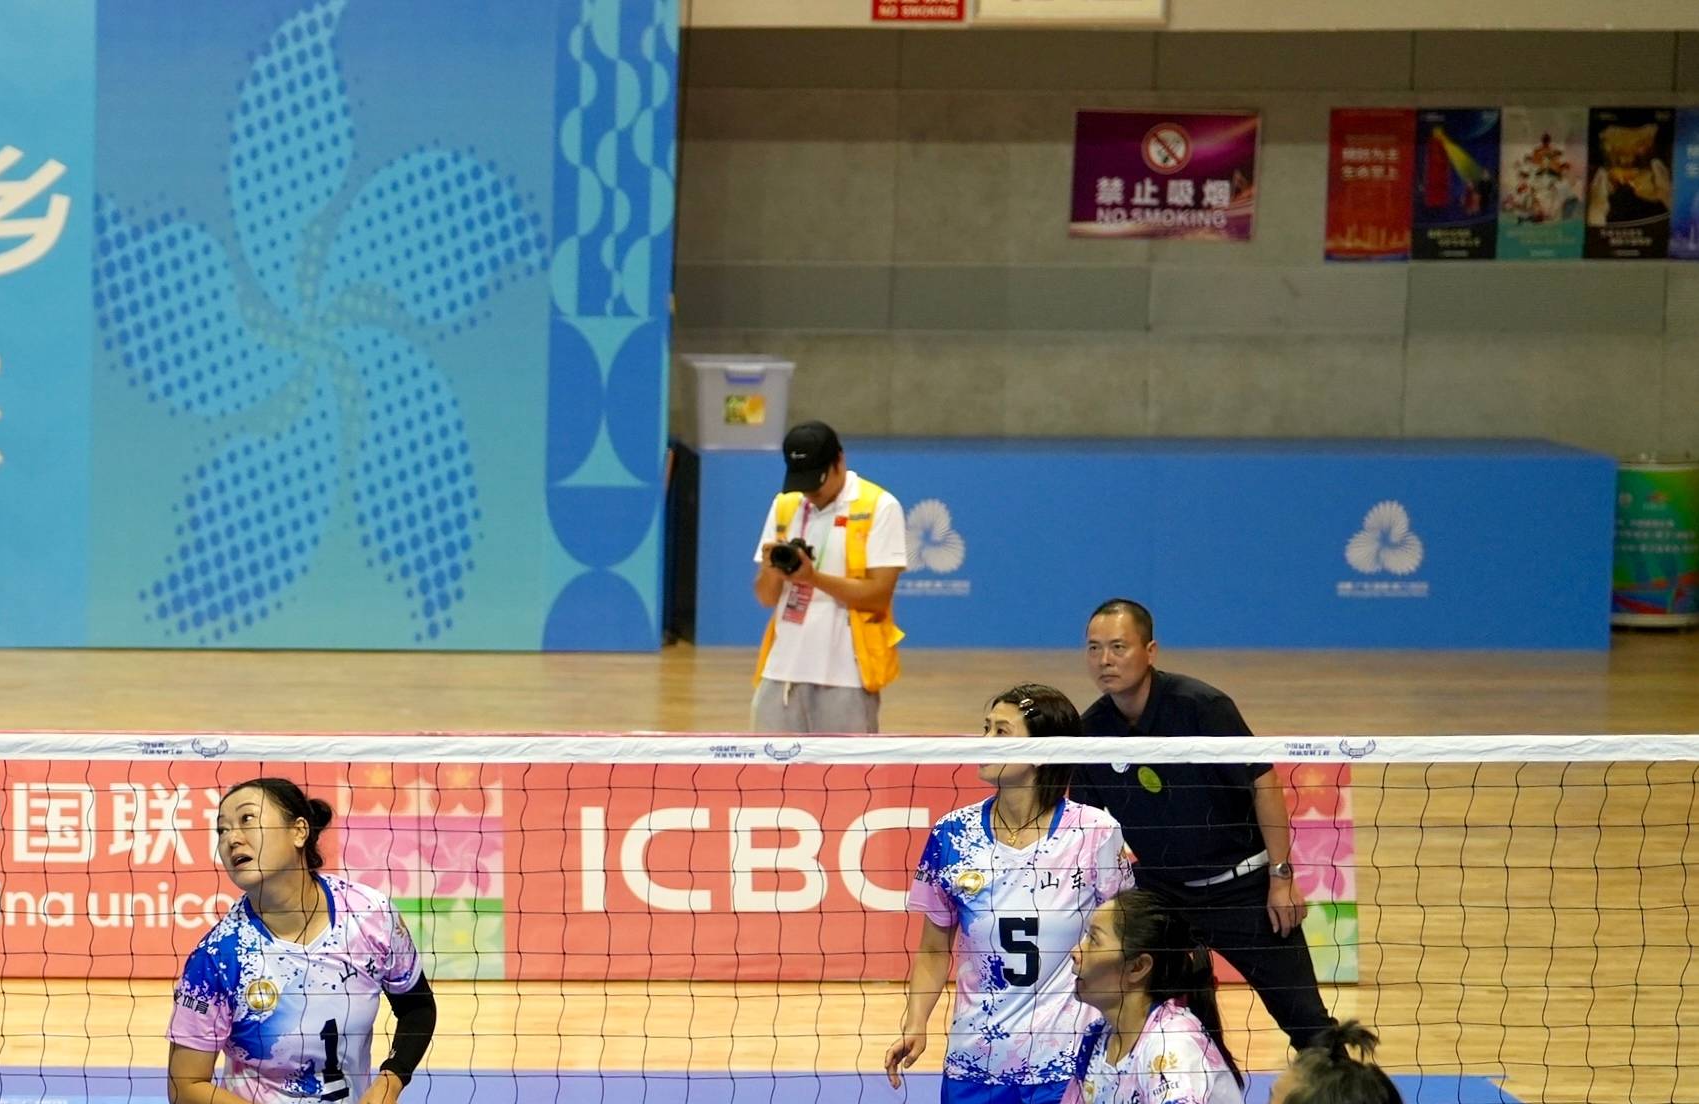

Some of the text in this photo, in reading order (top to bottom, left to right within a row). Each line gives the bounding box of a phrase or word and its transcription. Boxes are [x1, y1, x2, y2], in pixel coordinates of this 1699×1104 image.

[1095, 176, 1231, 208] 禁止吸烟
[1096, 207, 1227, 229] NO SMOKING
[581, 807, 930, 912] ICBC
[1041, 867, 1086, 890] 山东
[92, 882, 236, 929] unico
[339, 956, 379, 983] 山东
[999, 917, 1040, 987] 5
[320, 1018, 350, 1102] 1
